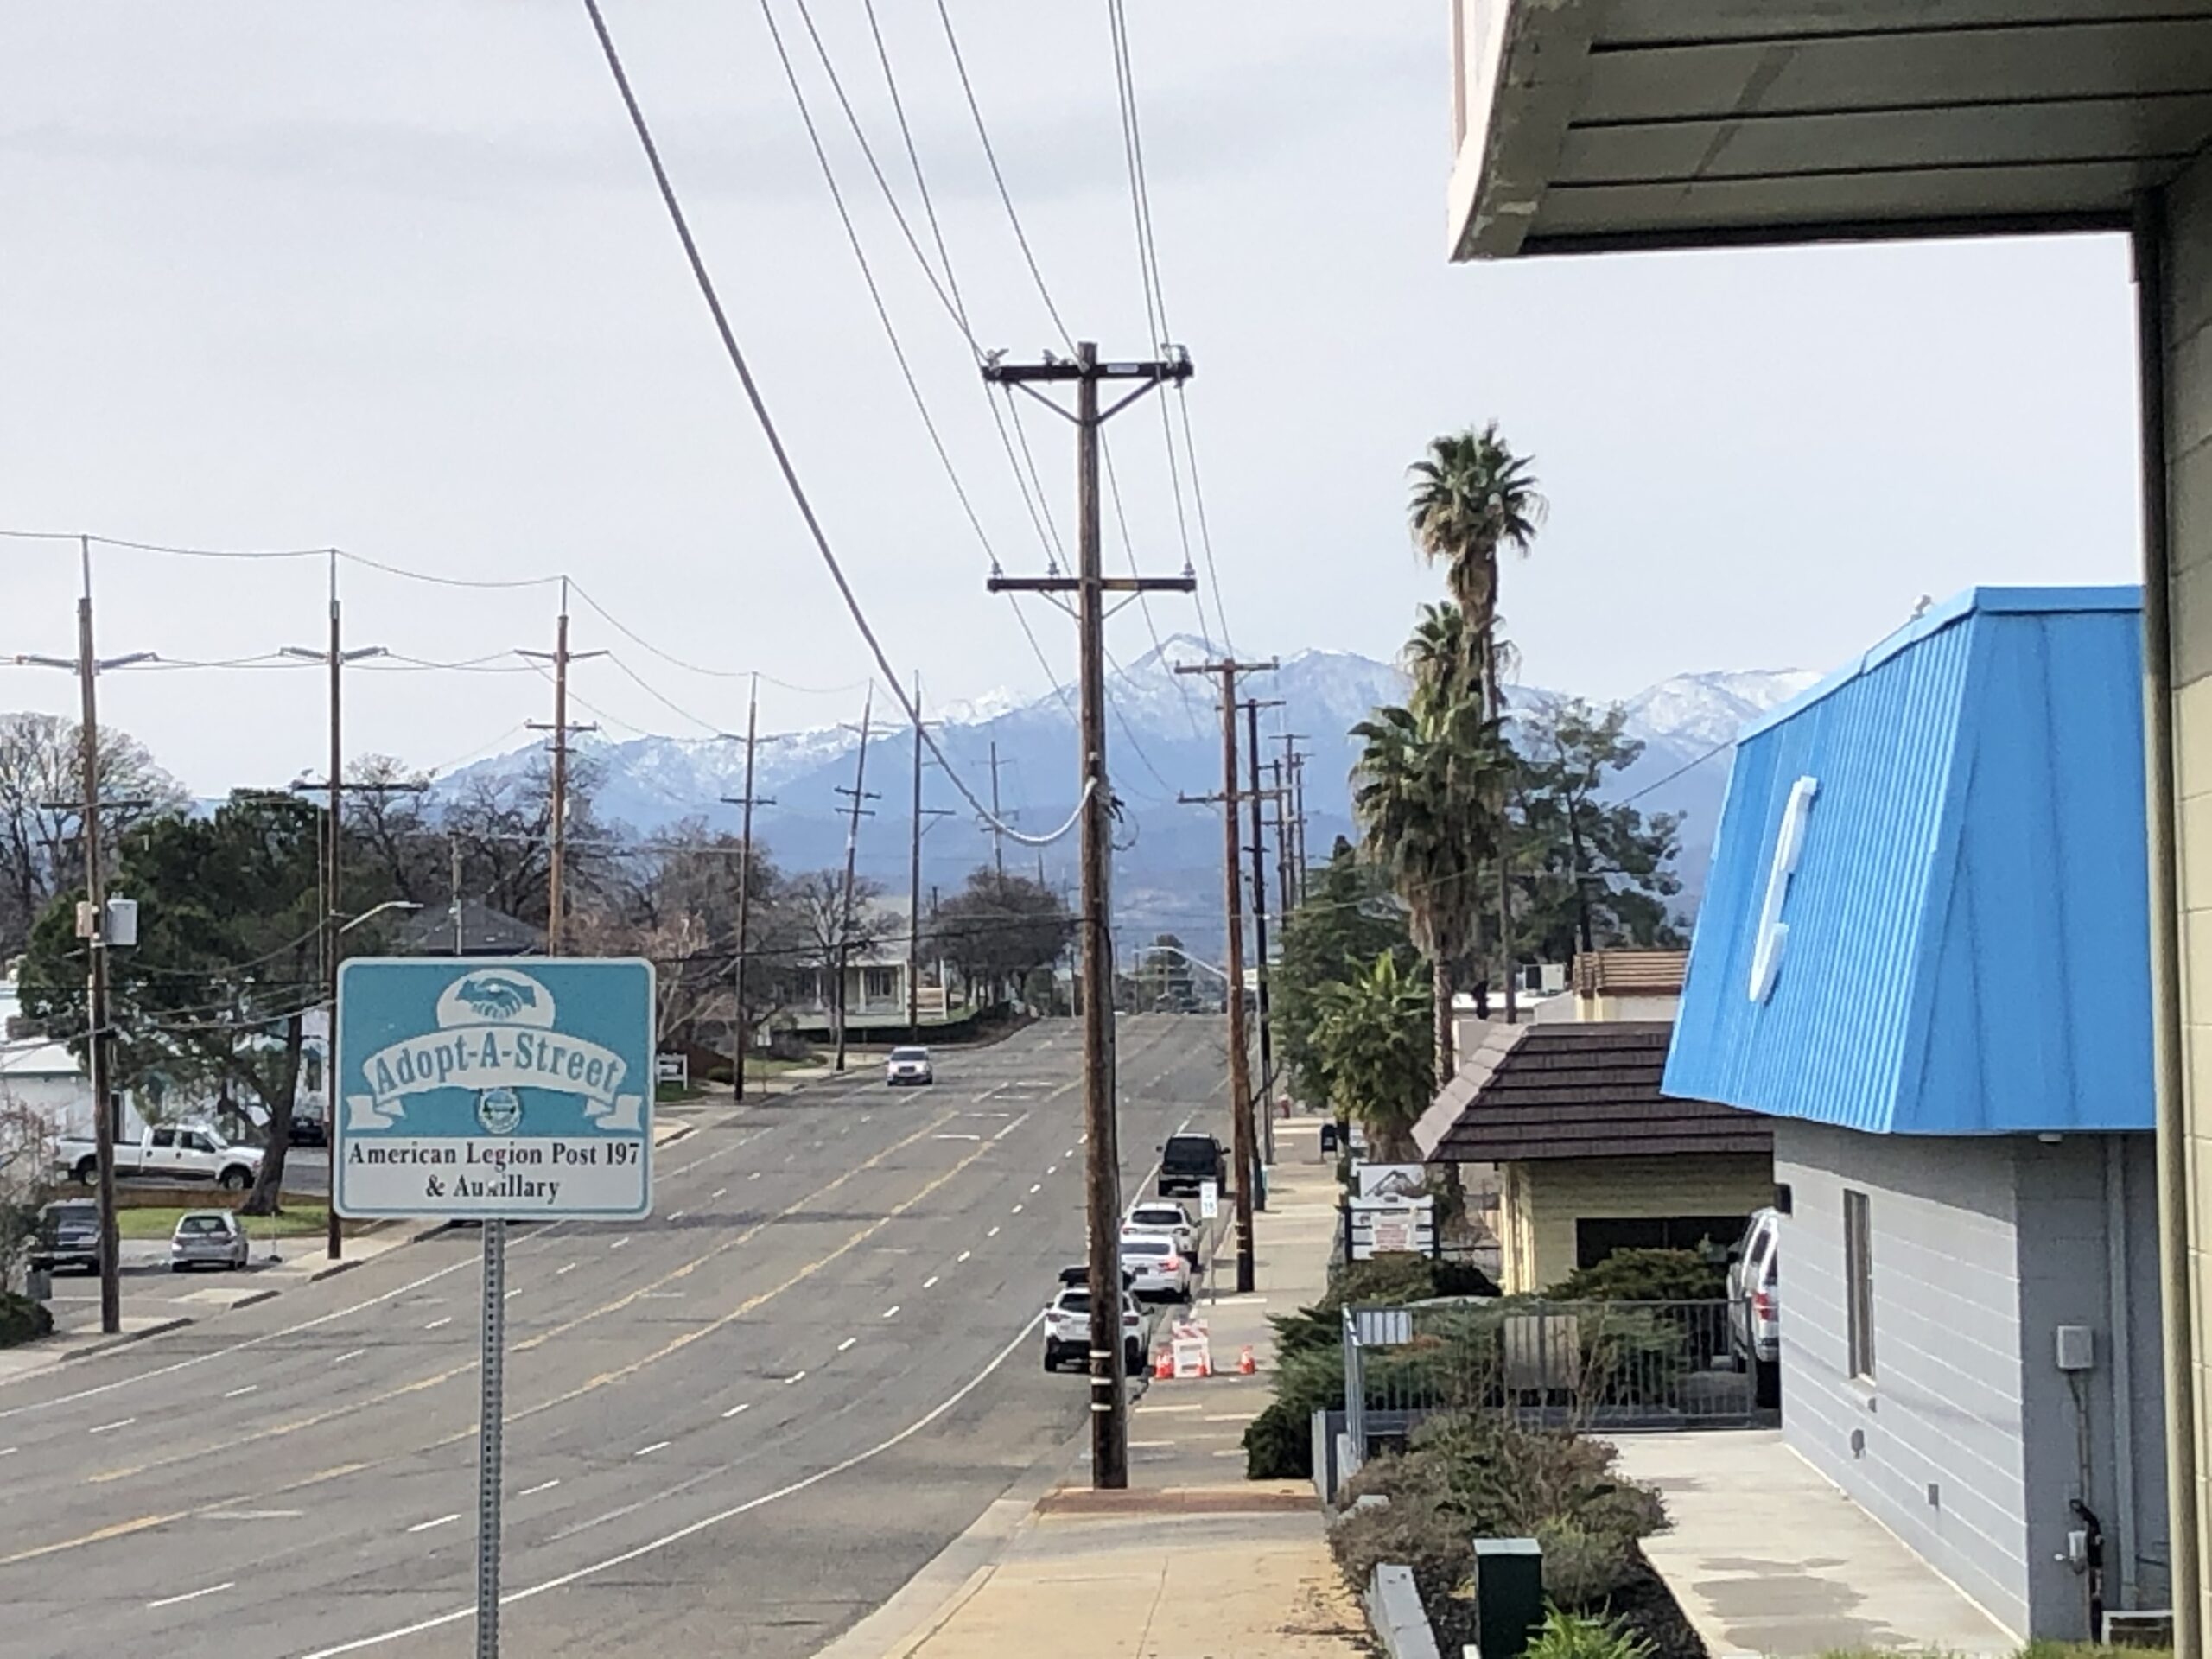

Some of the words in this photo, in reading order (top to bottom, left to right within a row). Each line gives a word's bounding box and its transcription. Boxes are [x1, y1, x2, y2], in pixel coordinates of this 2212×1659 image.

[374, 1031, 620, 1096] Adopt-A-Street
[348, 1141, 456, 1166] American
[466, 1141, 543, 1173] Legion
[552, 1142, 597, 1166] Post
[606, 1141, 640, 1166] 197
[425, 1173, 446, 1198] &
